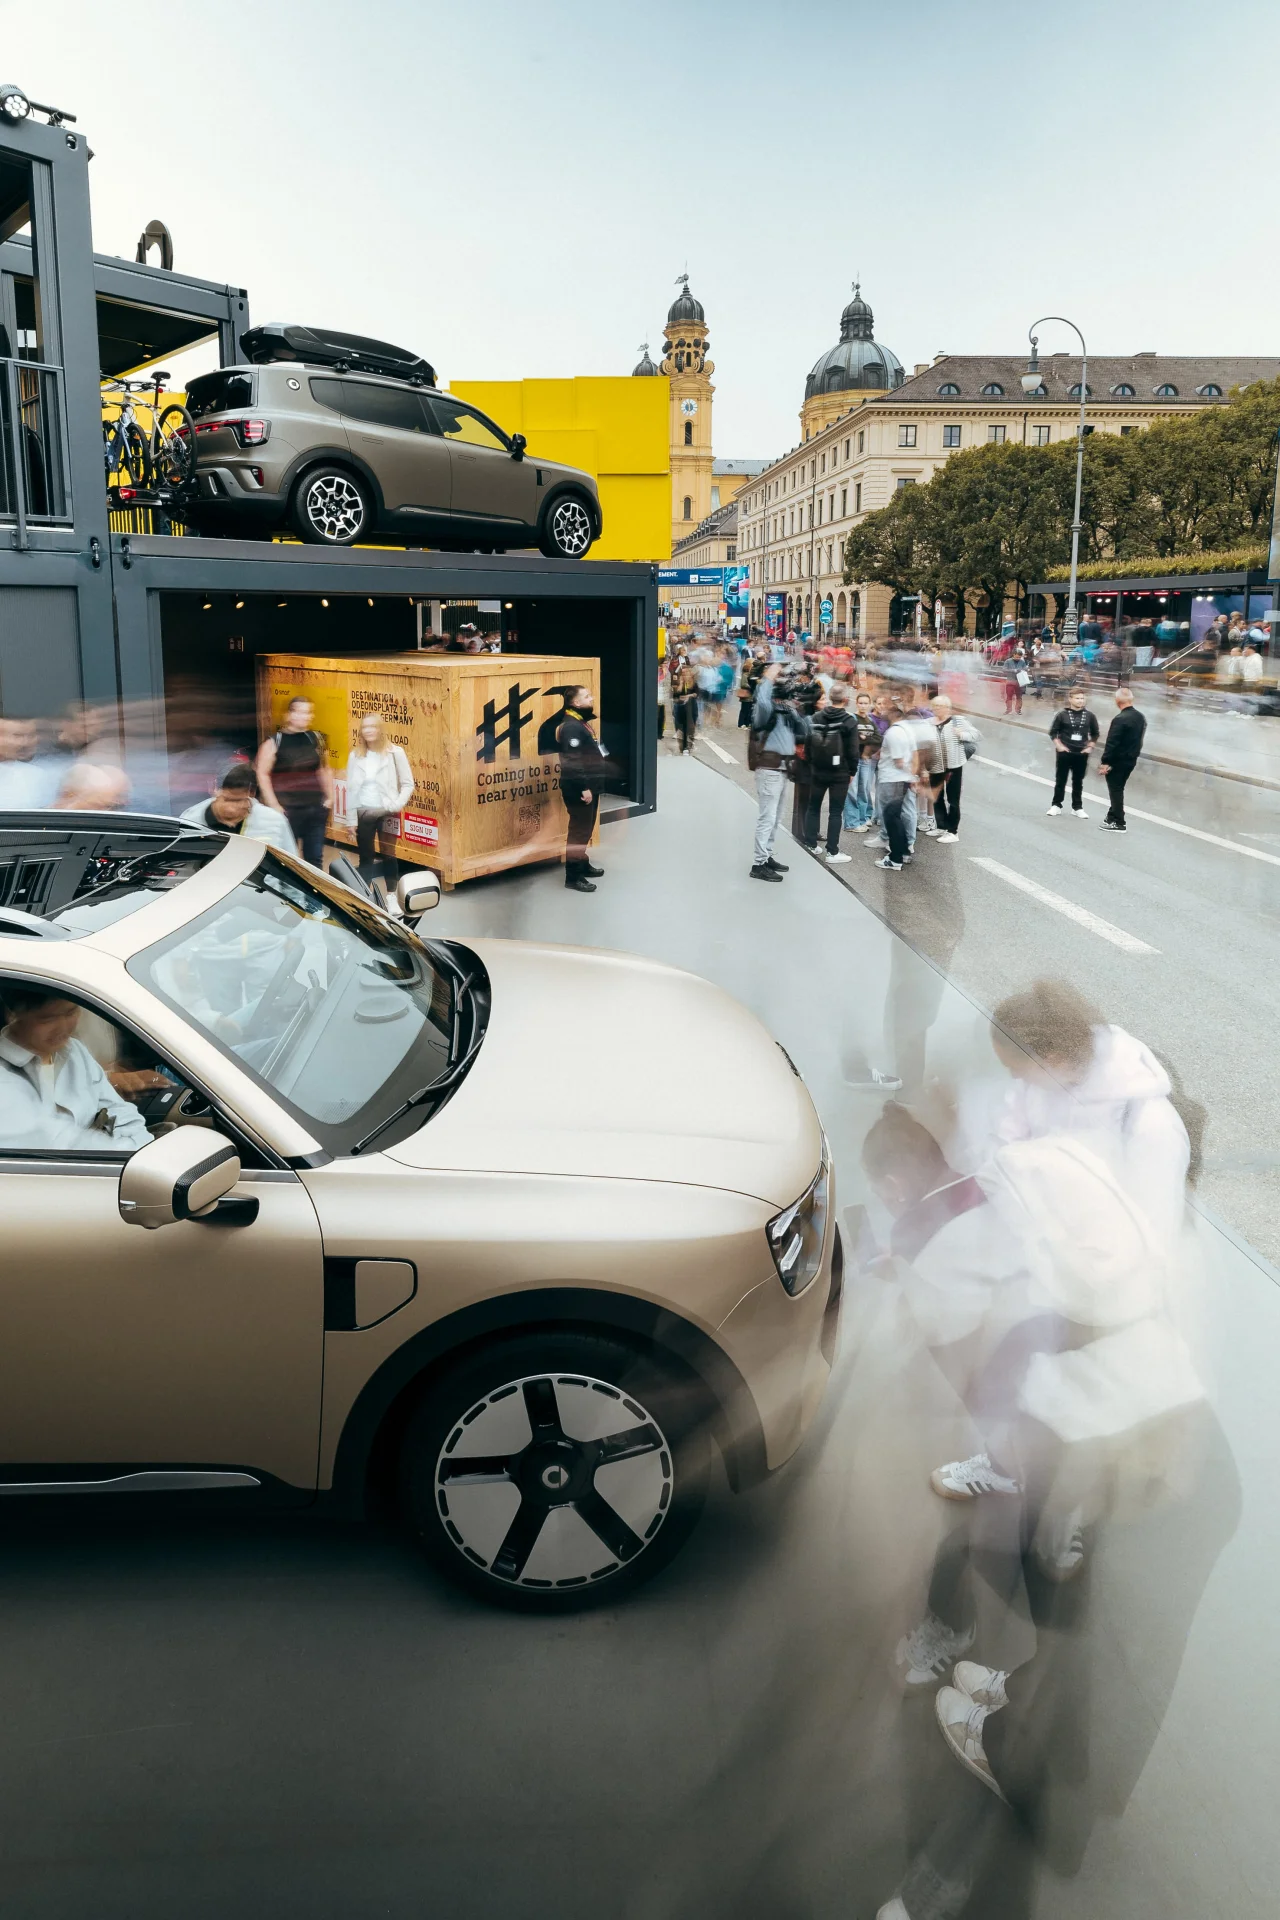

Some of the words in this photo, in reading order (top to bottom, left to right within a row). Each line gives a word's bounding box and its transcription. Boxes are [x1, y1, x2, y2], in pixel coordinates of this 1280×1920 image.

[352, 690, 394, 703] DESTINATION
[352, 700, 398, 714] ODEONSPLATZ
[399, 705, 408, 715] 18
[477, 767, 525, 787] Coming
[529, 765, 541, 778] to
[544, 763, 551, 774] a
[422, 780, 440, 792] 1800
[477, 788, 507, 804] near
[510, 782, 533, 801] you
[536, 779, 548, 795] in
[409, 824, 424, 834] SIGN
[424, 827, 433, 836] UP
